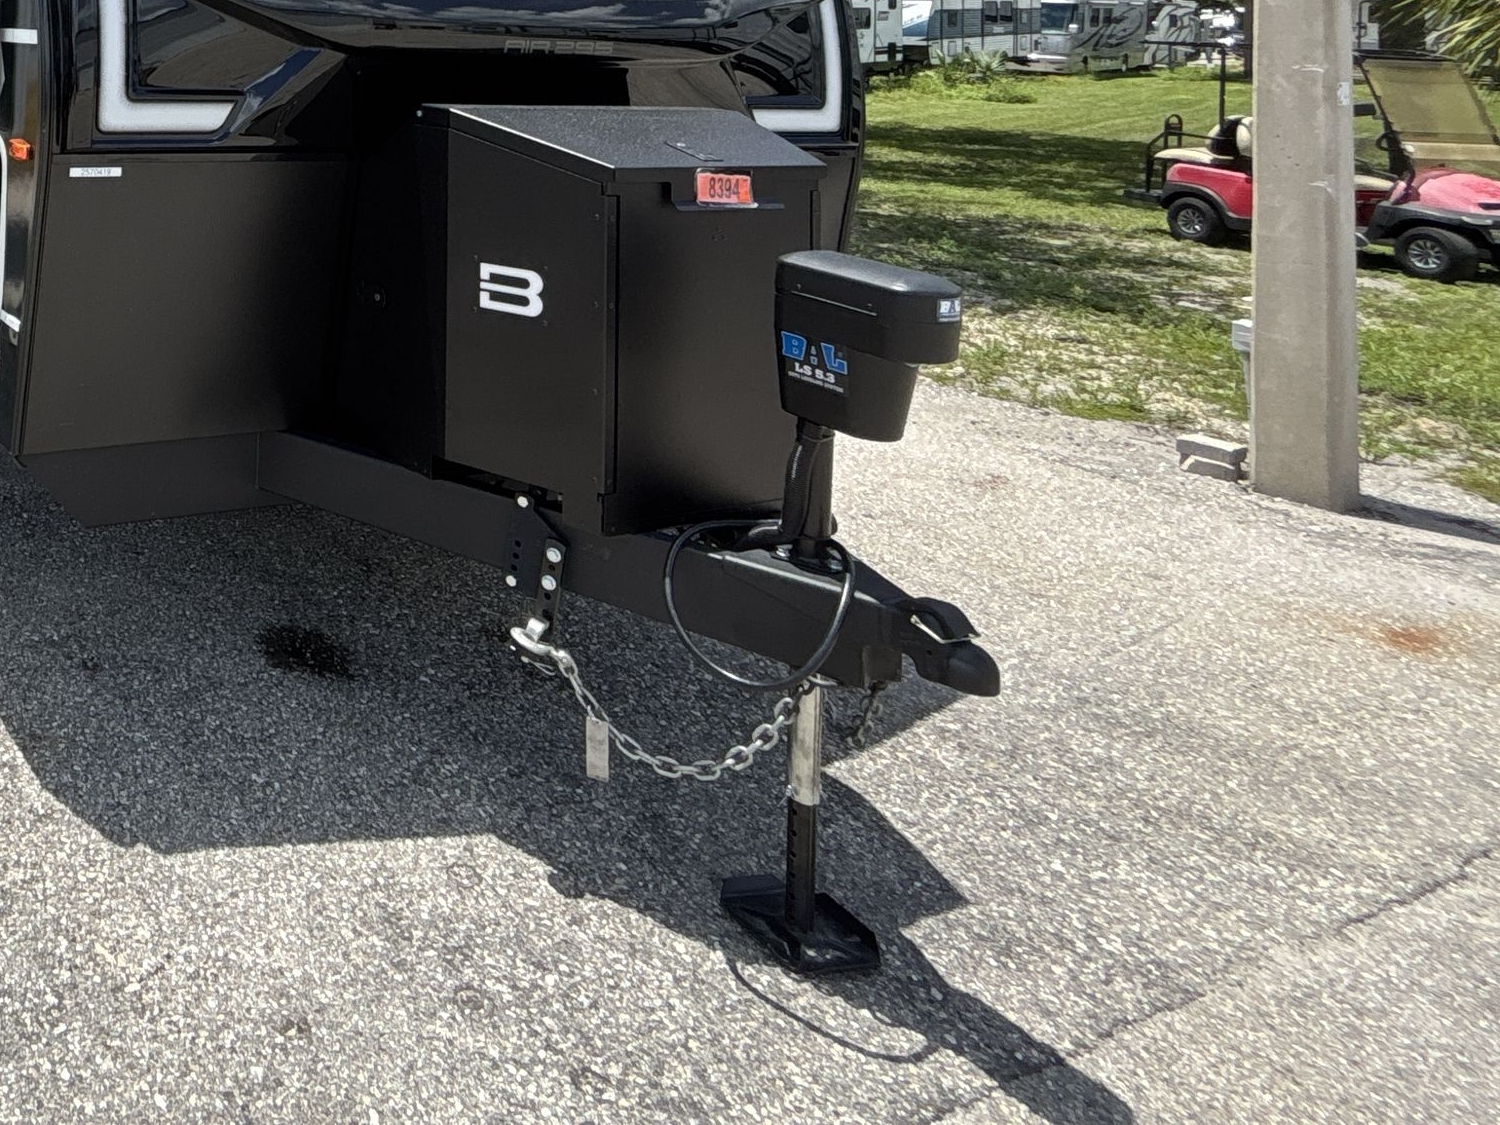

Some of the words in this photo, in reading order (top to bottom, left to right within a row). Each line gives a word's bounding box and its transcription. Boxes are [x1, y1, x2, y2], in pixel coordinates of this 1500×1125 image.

[503, 39, 551, 55] AIR
[554, 41, 614, 56] 295
[708, 176, 740, 198] 8394
[479, 262, 544, 317] B
[780, 330, 848, 375] BAL
[794, 361, 813, 376] LS
